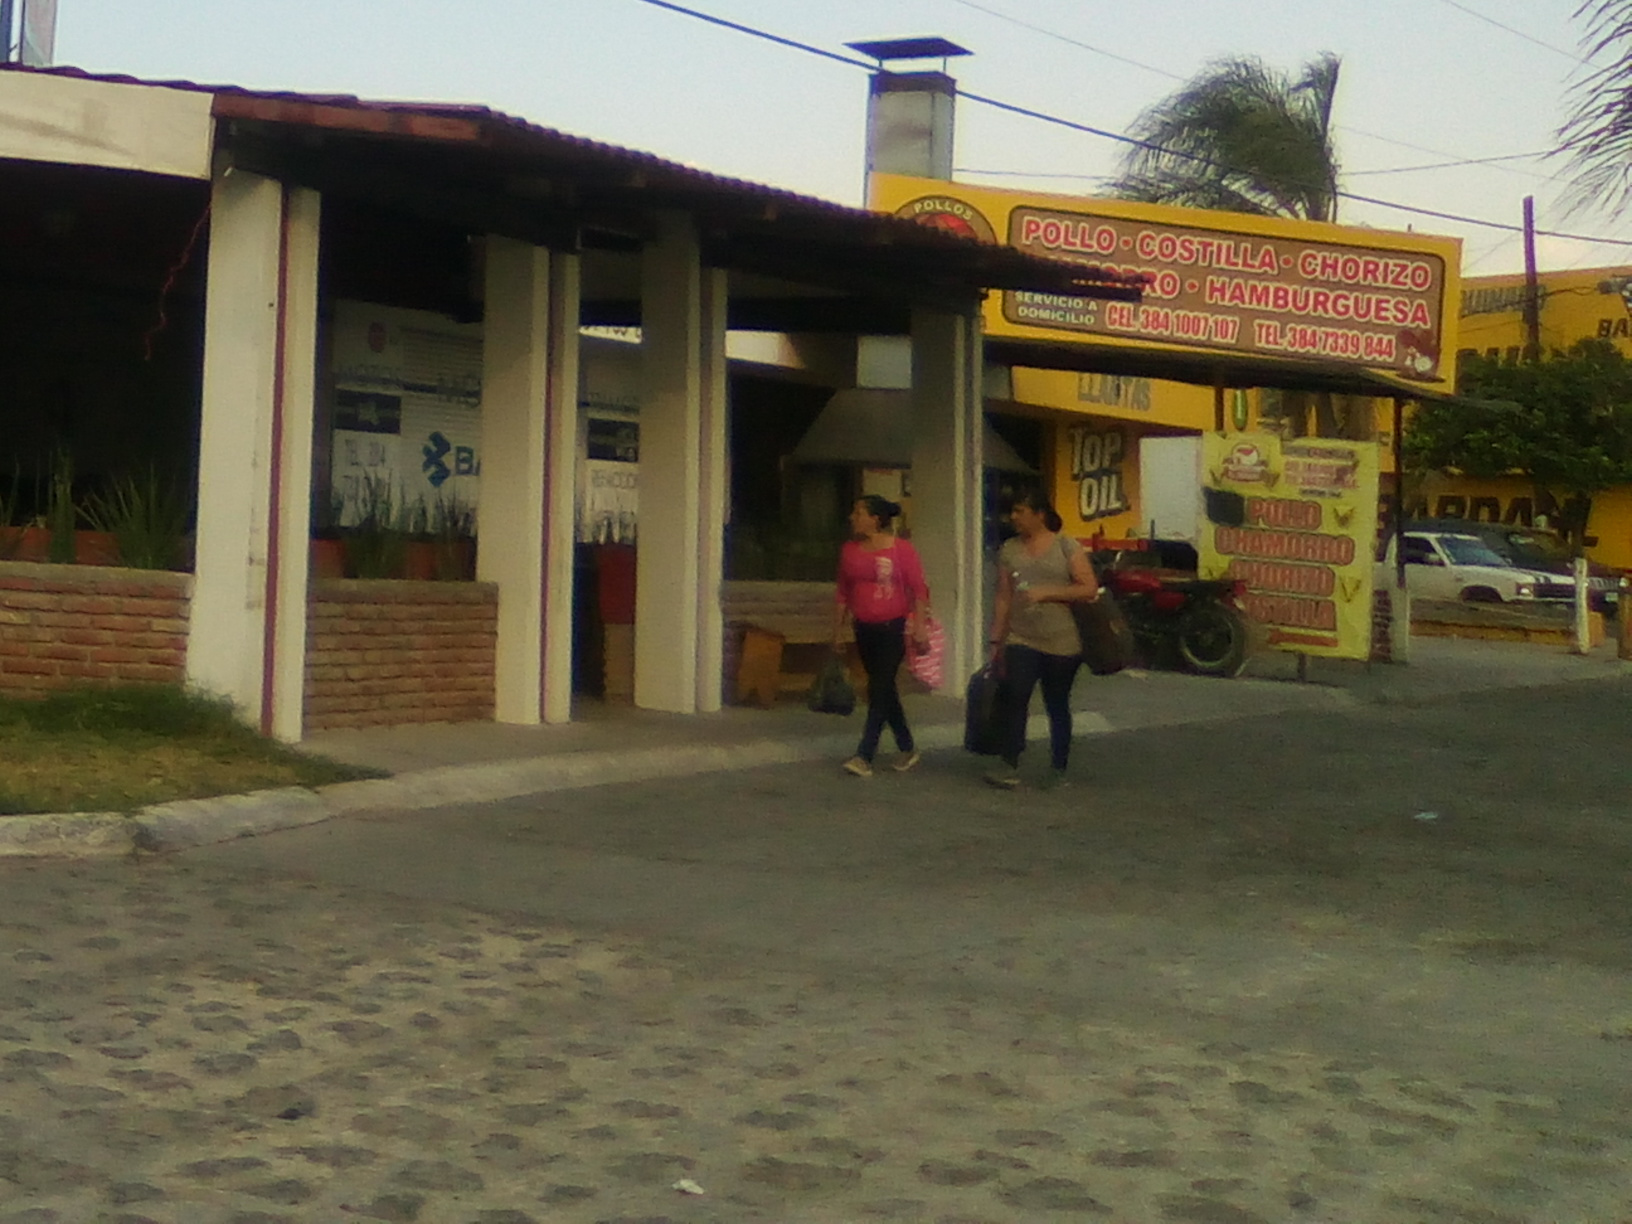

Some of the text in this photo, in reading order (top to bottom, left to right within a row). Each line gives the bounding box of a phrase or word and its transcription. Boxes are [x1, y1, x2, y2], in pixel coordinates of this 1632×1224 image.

[914, 200, 972, 220] POLLOS
[1021, 215, 1431, 291] POLLO COSTILLA CHORIZO
[1015, 291, 1098, 311] SERVICIO A
[1018, 306, 1095, 325] DOMICILIO
[1206, 276, 1431, 328] HAMBURGUESA
[1139, 305, 1171, 335] 384
[1210, 315, 1240, 343] 107
[1287, 323, 1319, 353] 384
[1320, 326, 1361, 358] 7339
[1362, 332, 1396, 361] 844
[1067, 426, 1123, 477] TOP
[1079, 474, 1125, 519] OIL
[1246, 497, 1322, 530] POLLO
[1215, 527, 1356, 566] CHAMORRO
